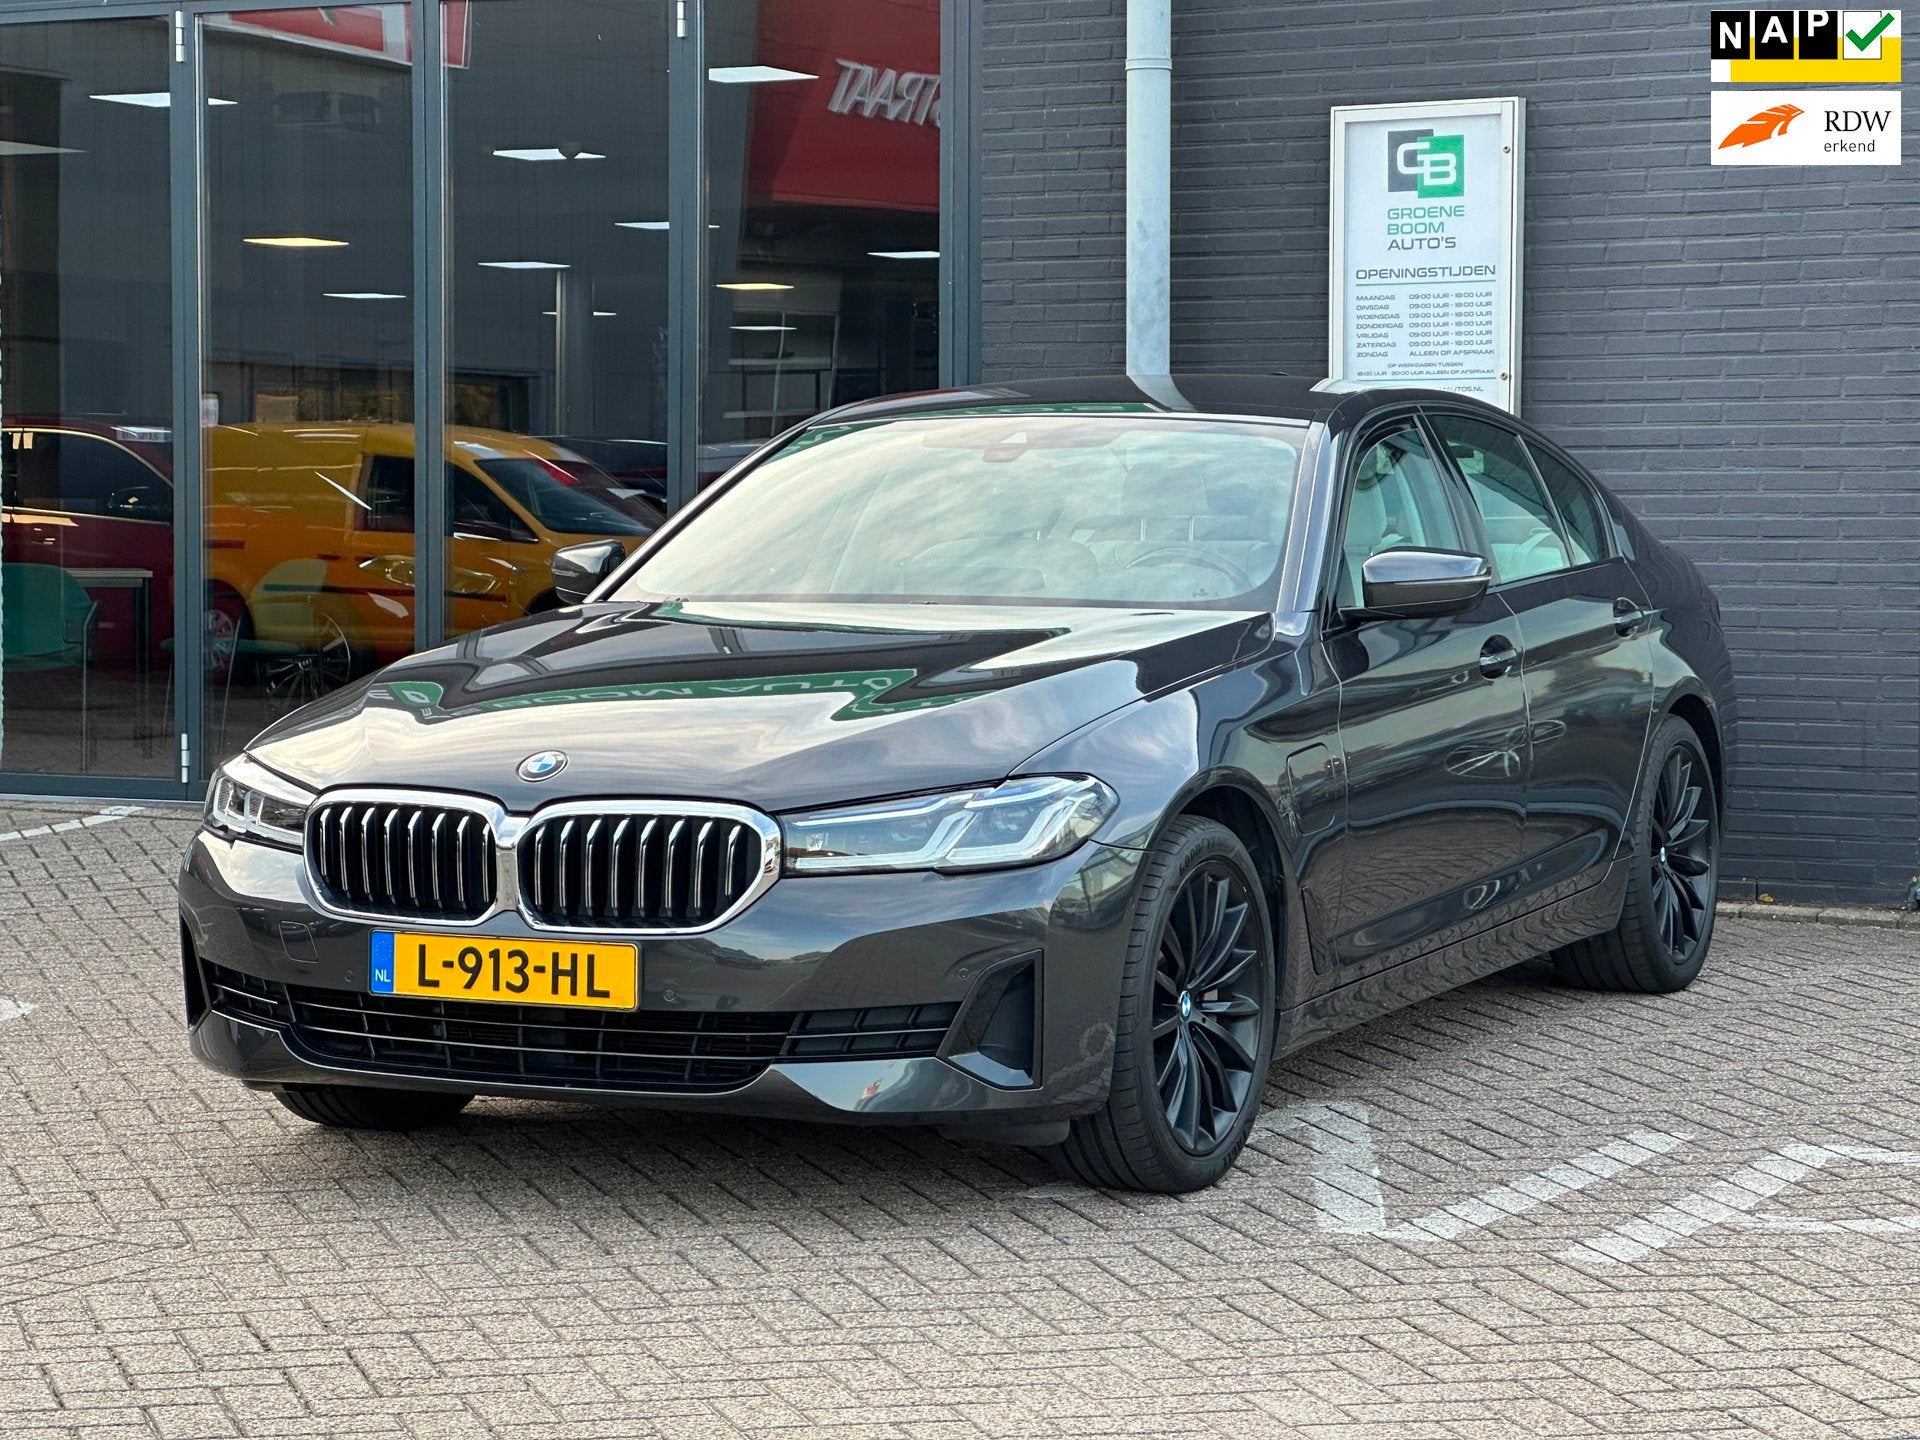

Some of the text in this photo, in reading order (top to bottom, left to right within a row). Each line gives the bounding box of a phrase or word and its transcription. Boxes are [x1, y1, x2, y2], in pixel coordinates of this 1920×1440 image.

[1387, 205, 1465, 220] GROENE
[1387, 222, 1445, 235] BOOM
[1387, 236, 1456, 251] AUTO'S
[1355, 264, 1496, 280] OPENINGSTIJDEN
[375, 969, 391, 982] NL
[417, 943, 611, 999] L-913-HL
